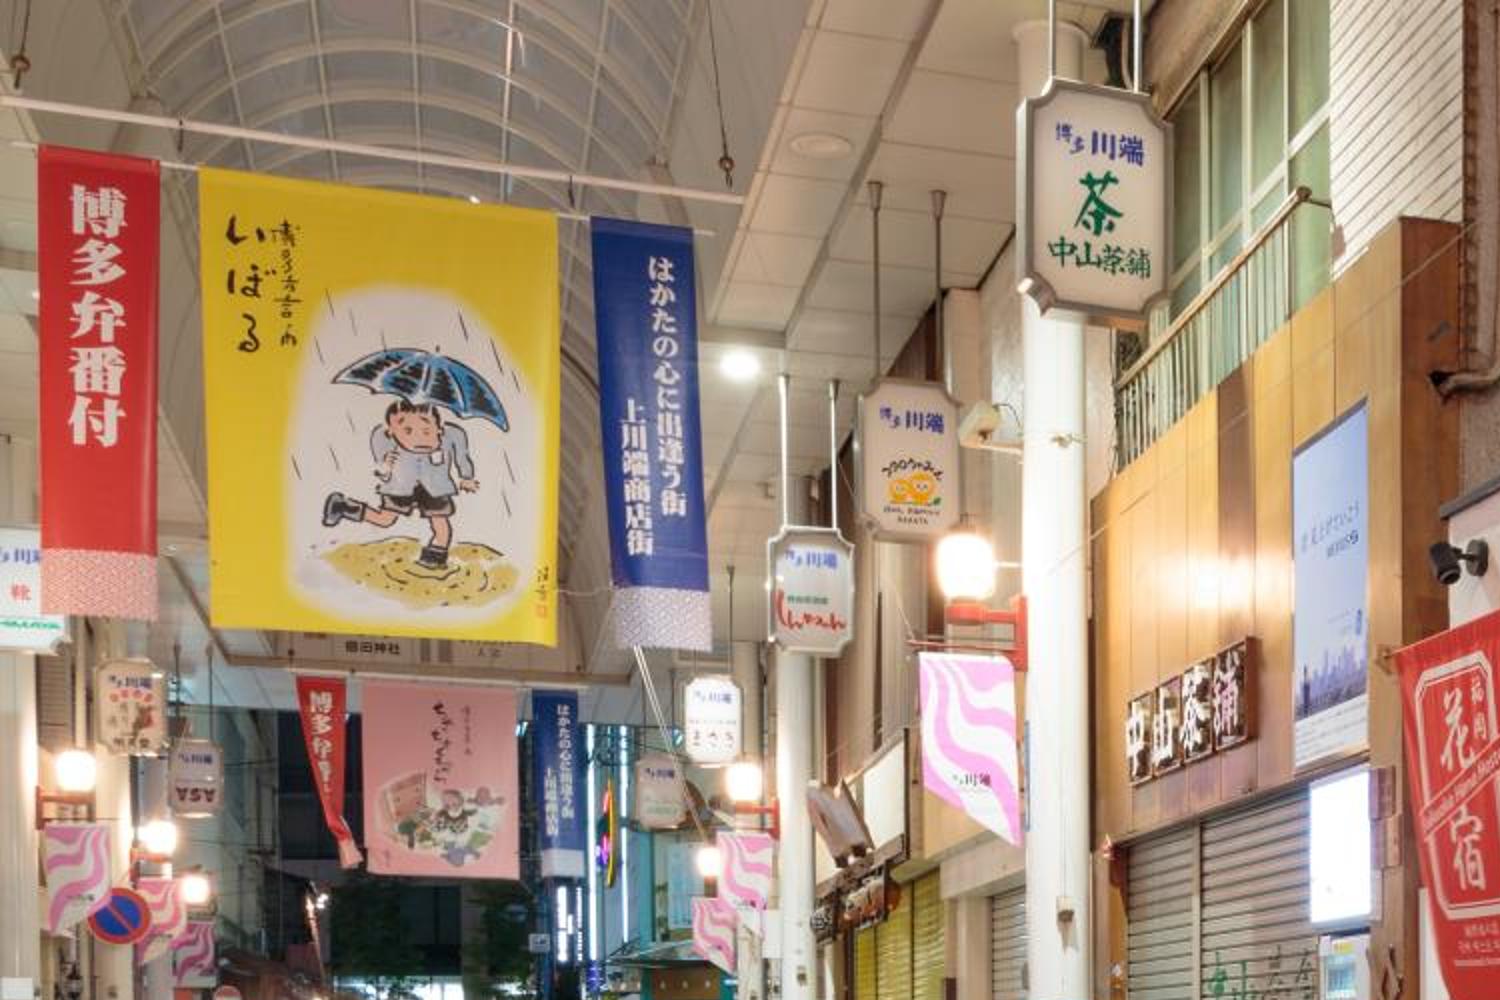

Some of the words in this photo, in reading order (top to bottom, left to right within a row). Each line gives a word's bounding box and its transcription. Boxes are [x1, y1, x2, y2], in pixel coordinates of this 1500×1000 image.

[1056, 122, 1144, 166] 博多川端
[1073, 171, 1124, 236] 茶
[68, 184, 128, 447] 博多弁番付
[226, 215, 276, 352] いぼる
[648, 256, 687, 516] はかたの心に出逢う街
[620, 398, 654, 555] 上川端商店街
